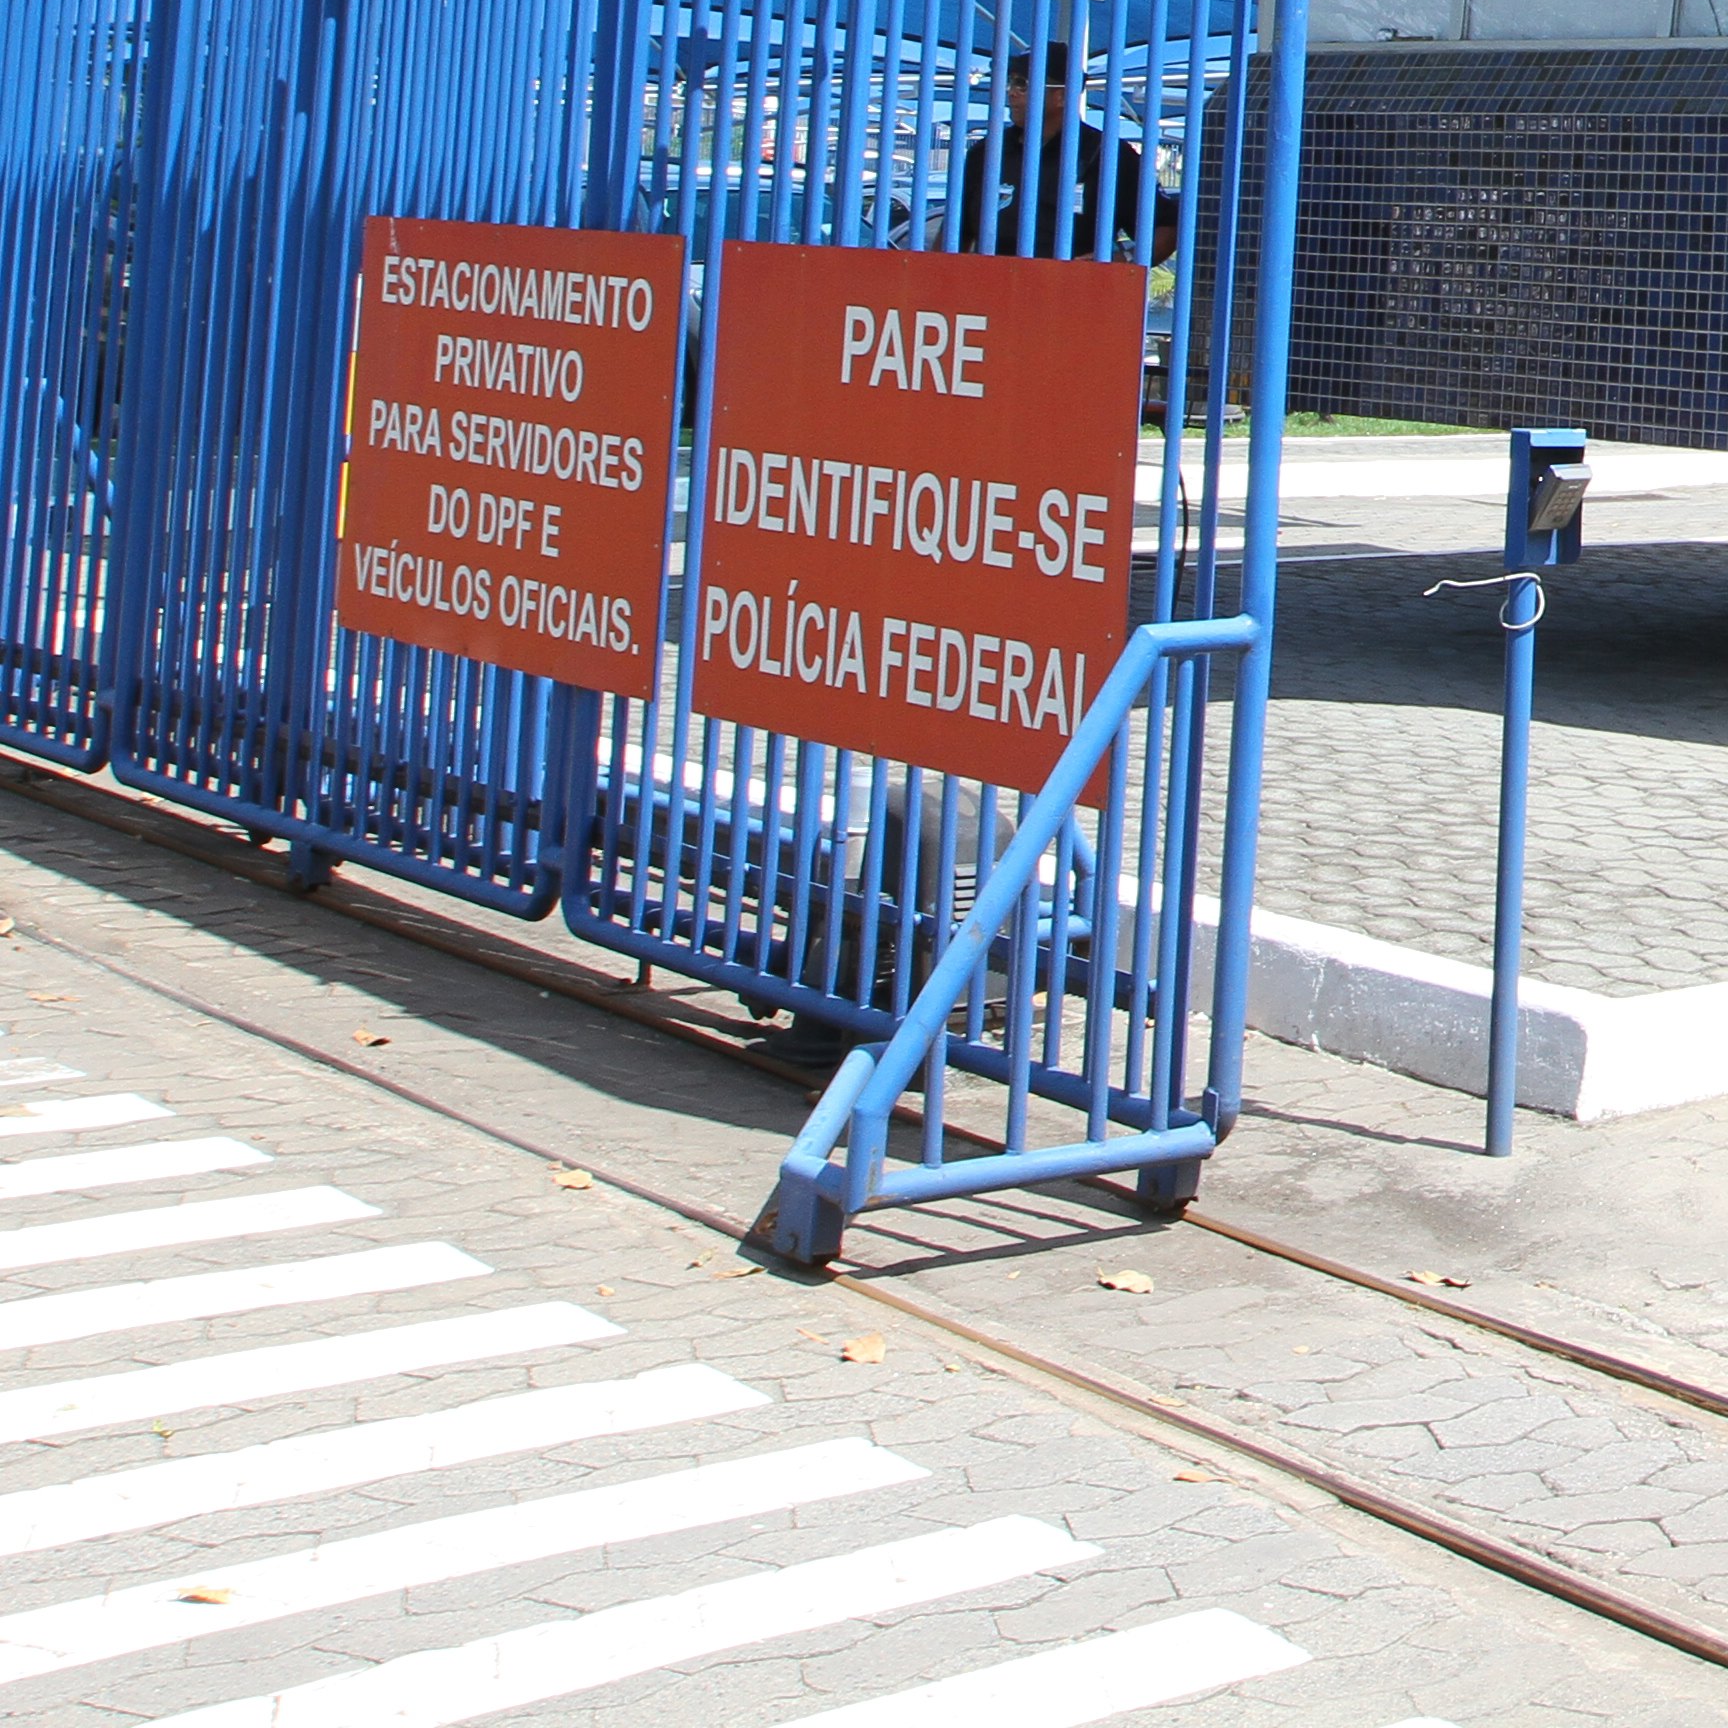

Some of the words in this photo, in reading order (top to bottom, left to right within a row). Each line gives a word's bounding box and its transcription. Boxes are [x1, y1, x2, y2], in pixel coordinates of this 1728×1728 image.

[381, 255, 652, 332] ESTACIONAMENTO
[434, 334, 584, 402] PRIVATIVO
[841, 304, 988, 398] PARE
[369, 399, 441, 457] PARA
[449, 411, 644, 491] SERVIDORES
[428, 484, 470, 538] DO
[477, 492, 534, 550] DPF
[541, 504, 561, 557] E
[714, 447, 1109, 582] IDENTIFIQUE-SE
[354, 539, 491, 620] VEÍCULOS
[500, 575, 639, 655] OFICIAIS.
[703, 579, 867, 694] POLÍCIA
